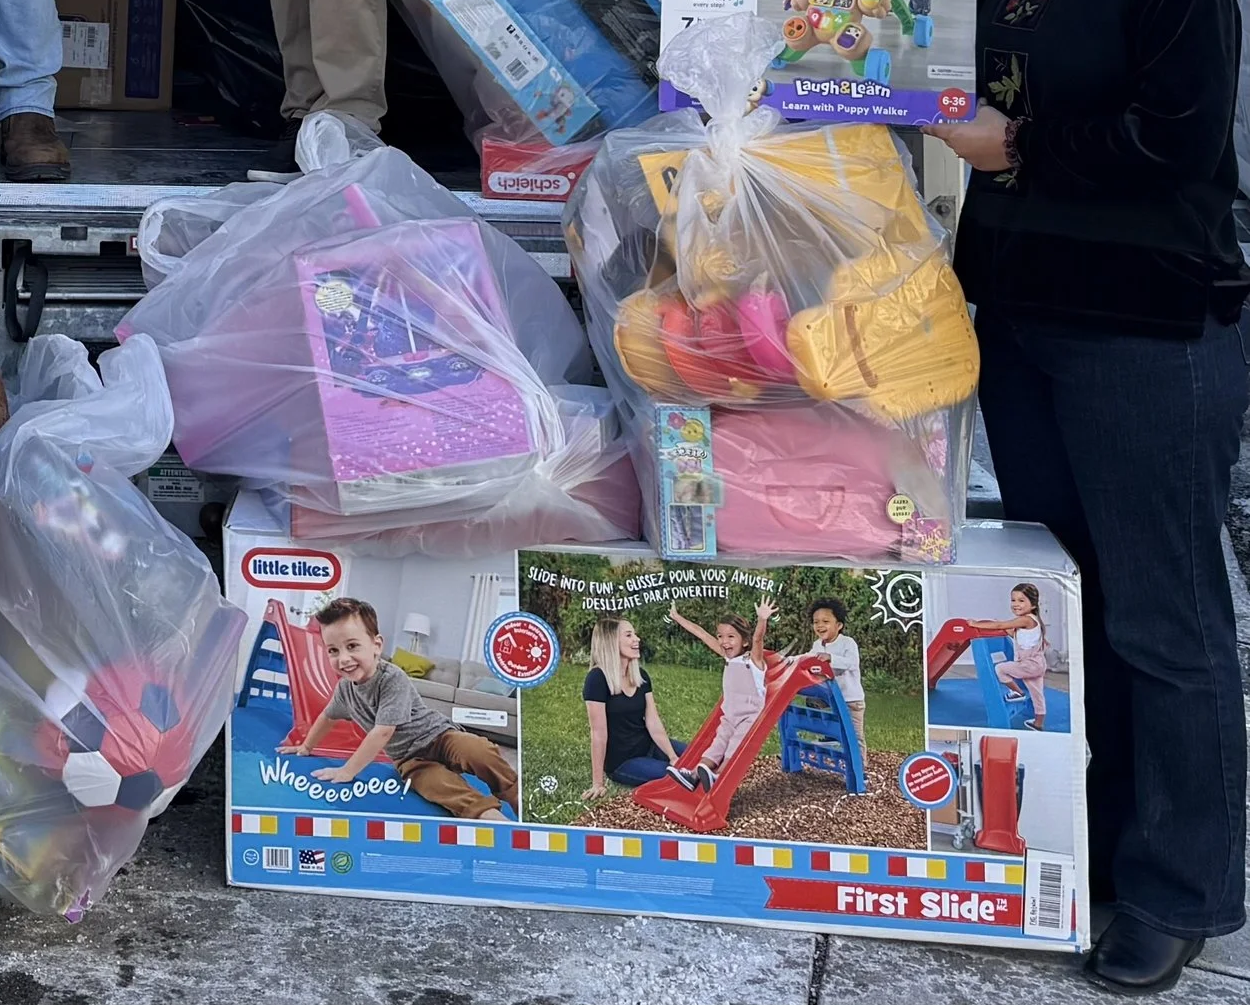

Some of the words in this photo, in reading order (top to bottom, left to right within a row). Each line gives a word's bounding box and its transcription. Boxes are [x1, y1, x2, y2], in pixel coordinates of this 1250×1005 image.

[782, 101, 810, 111] Learn
[813, 102, 834, 112] with
[836, 104, 869, 116] Puppy
[872, 106, 909, 117] Walker
[942, 96, 966, 106] 6-36
[497, 174, 563, 192] schleich
[252, 558, 290, 577] little
[292, 561, 331, 578] tikes
[528, 566, 557, 586] SLIDE
[590, 582, 614, 595] FUN!
[625, 572, 665, 593] GLISSEZ
[668, 570, 697, 585] POUR
[701, 568, 727, 584] VOUS
[731, 570, 774, 593] AMUSER
[643, 588, 671, 604] PARA
[836, 886, 909, 915] First
[920, 892, 995, 922] Slide
